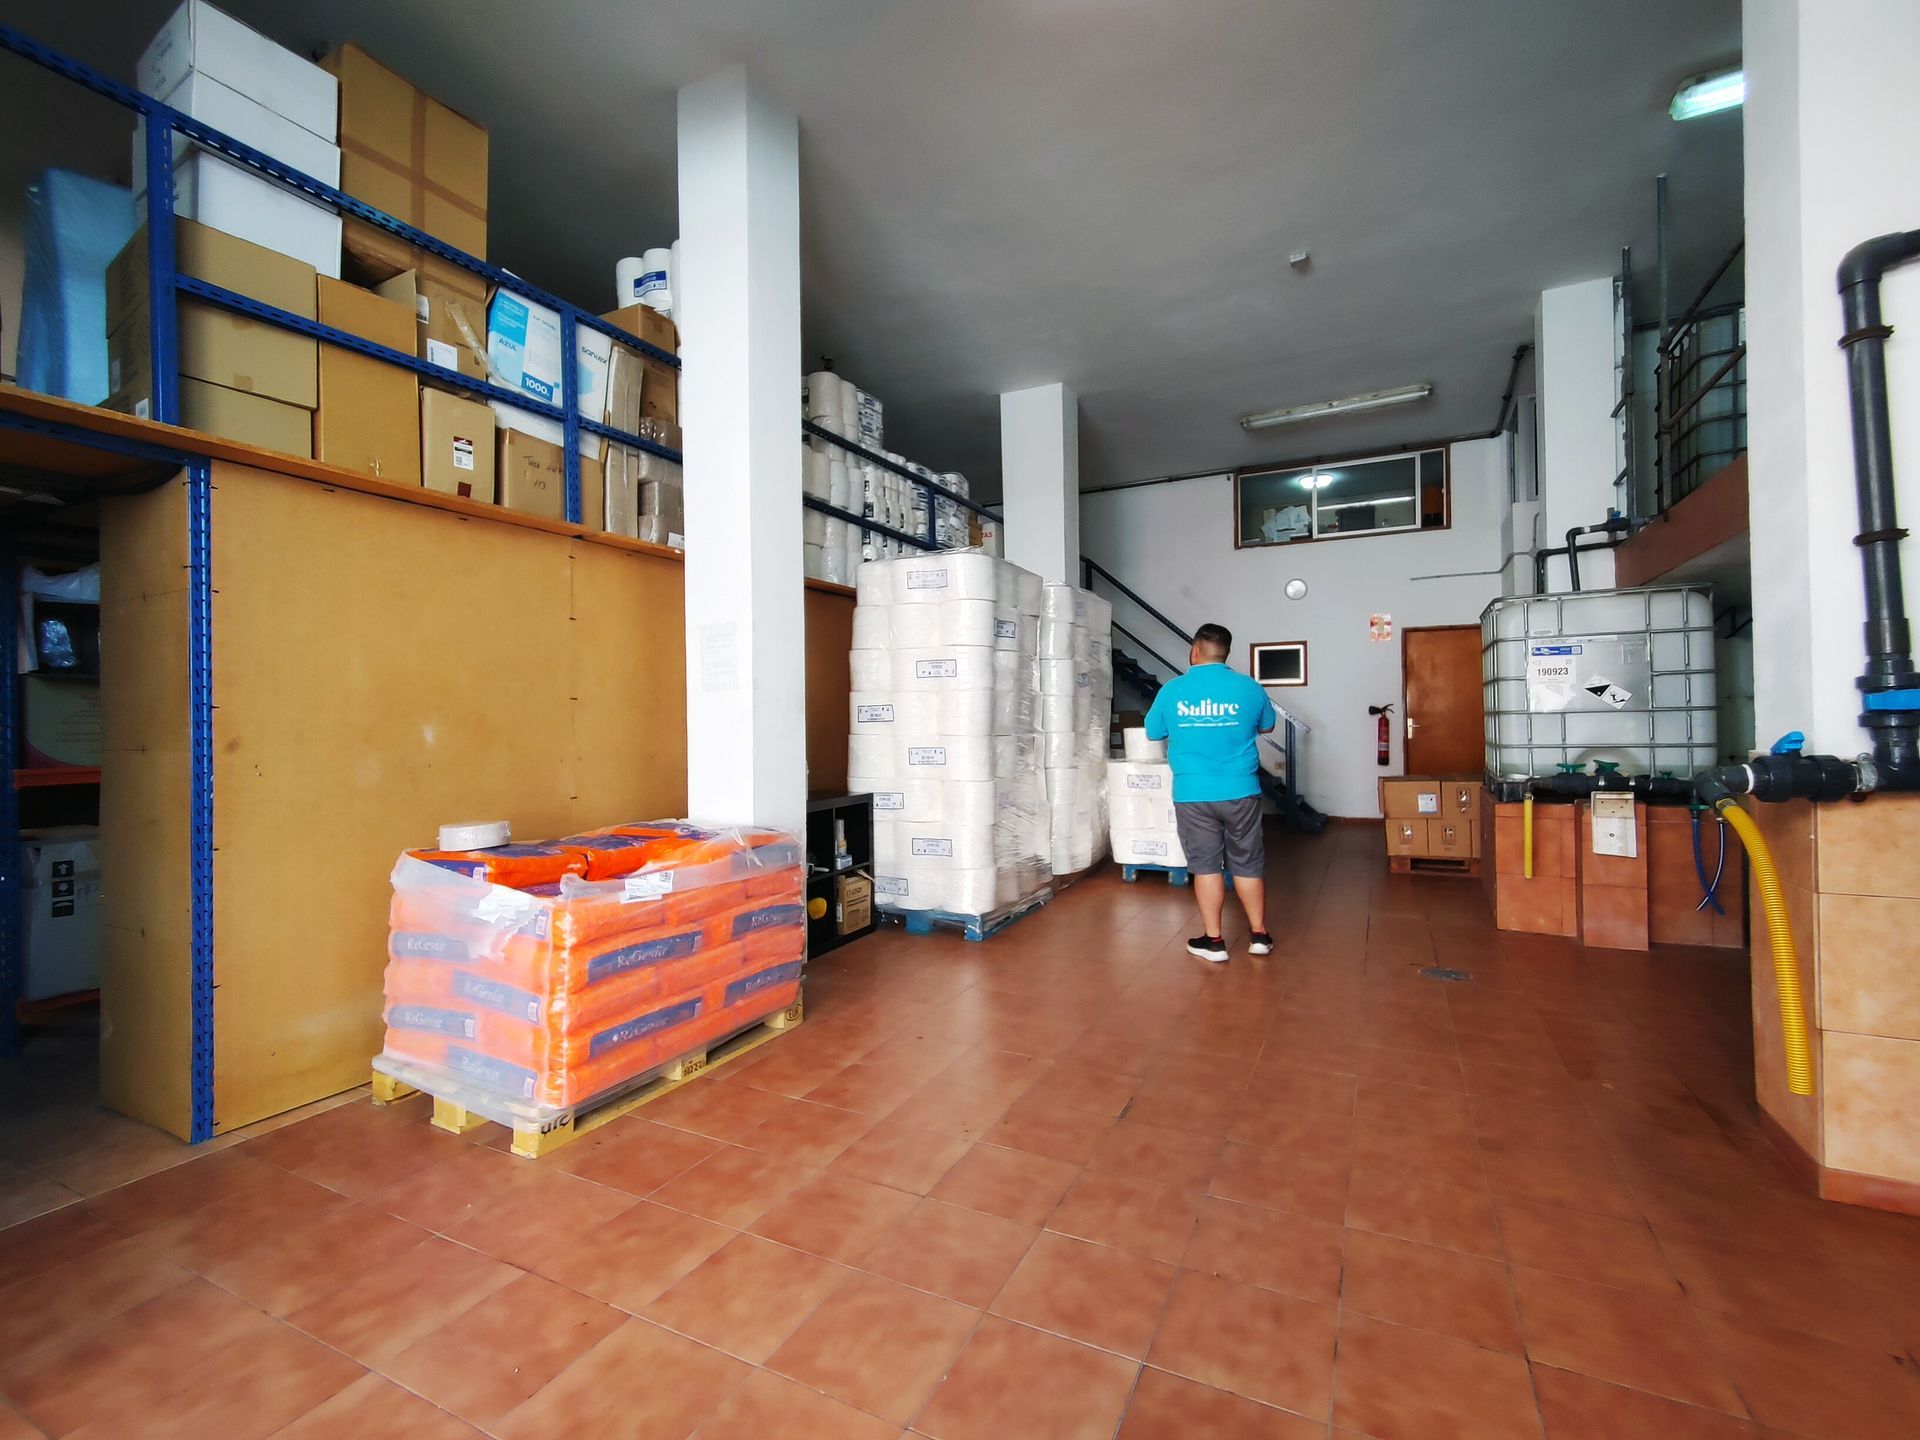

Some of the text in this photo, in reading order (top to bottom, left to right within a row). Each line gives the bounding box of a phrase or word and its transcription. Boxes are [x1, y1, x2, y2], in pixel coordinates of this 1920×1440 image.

[499, 337, 518, 352] AZUL
[525, 376, 547, 395] 1000
[1537, 667, 1569, 676] 190923
[1177, 697, 1240, 716] Salitre
